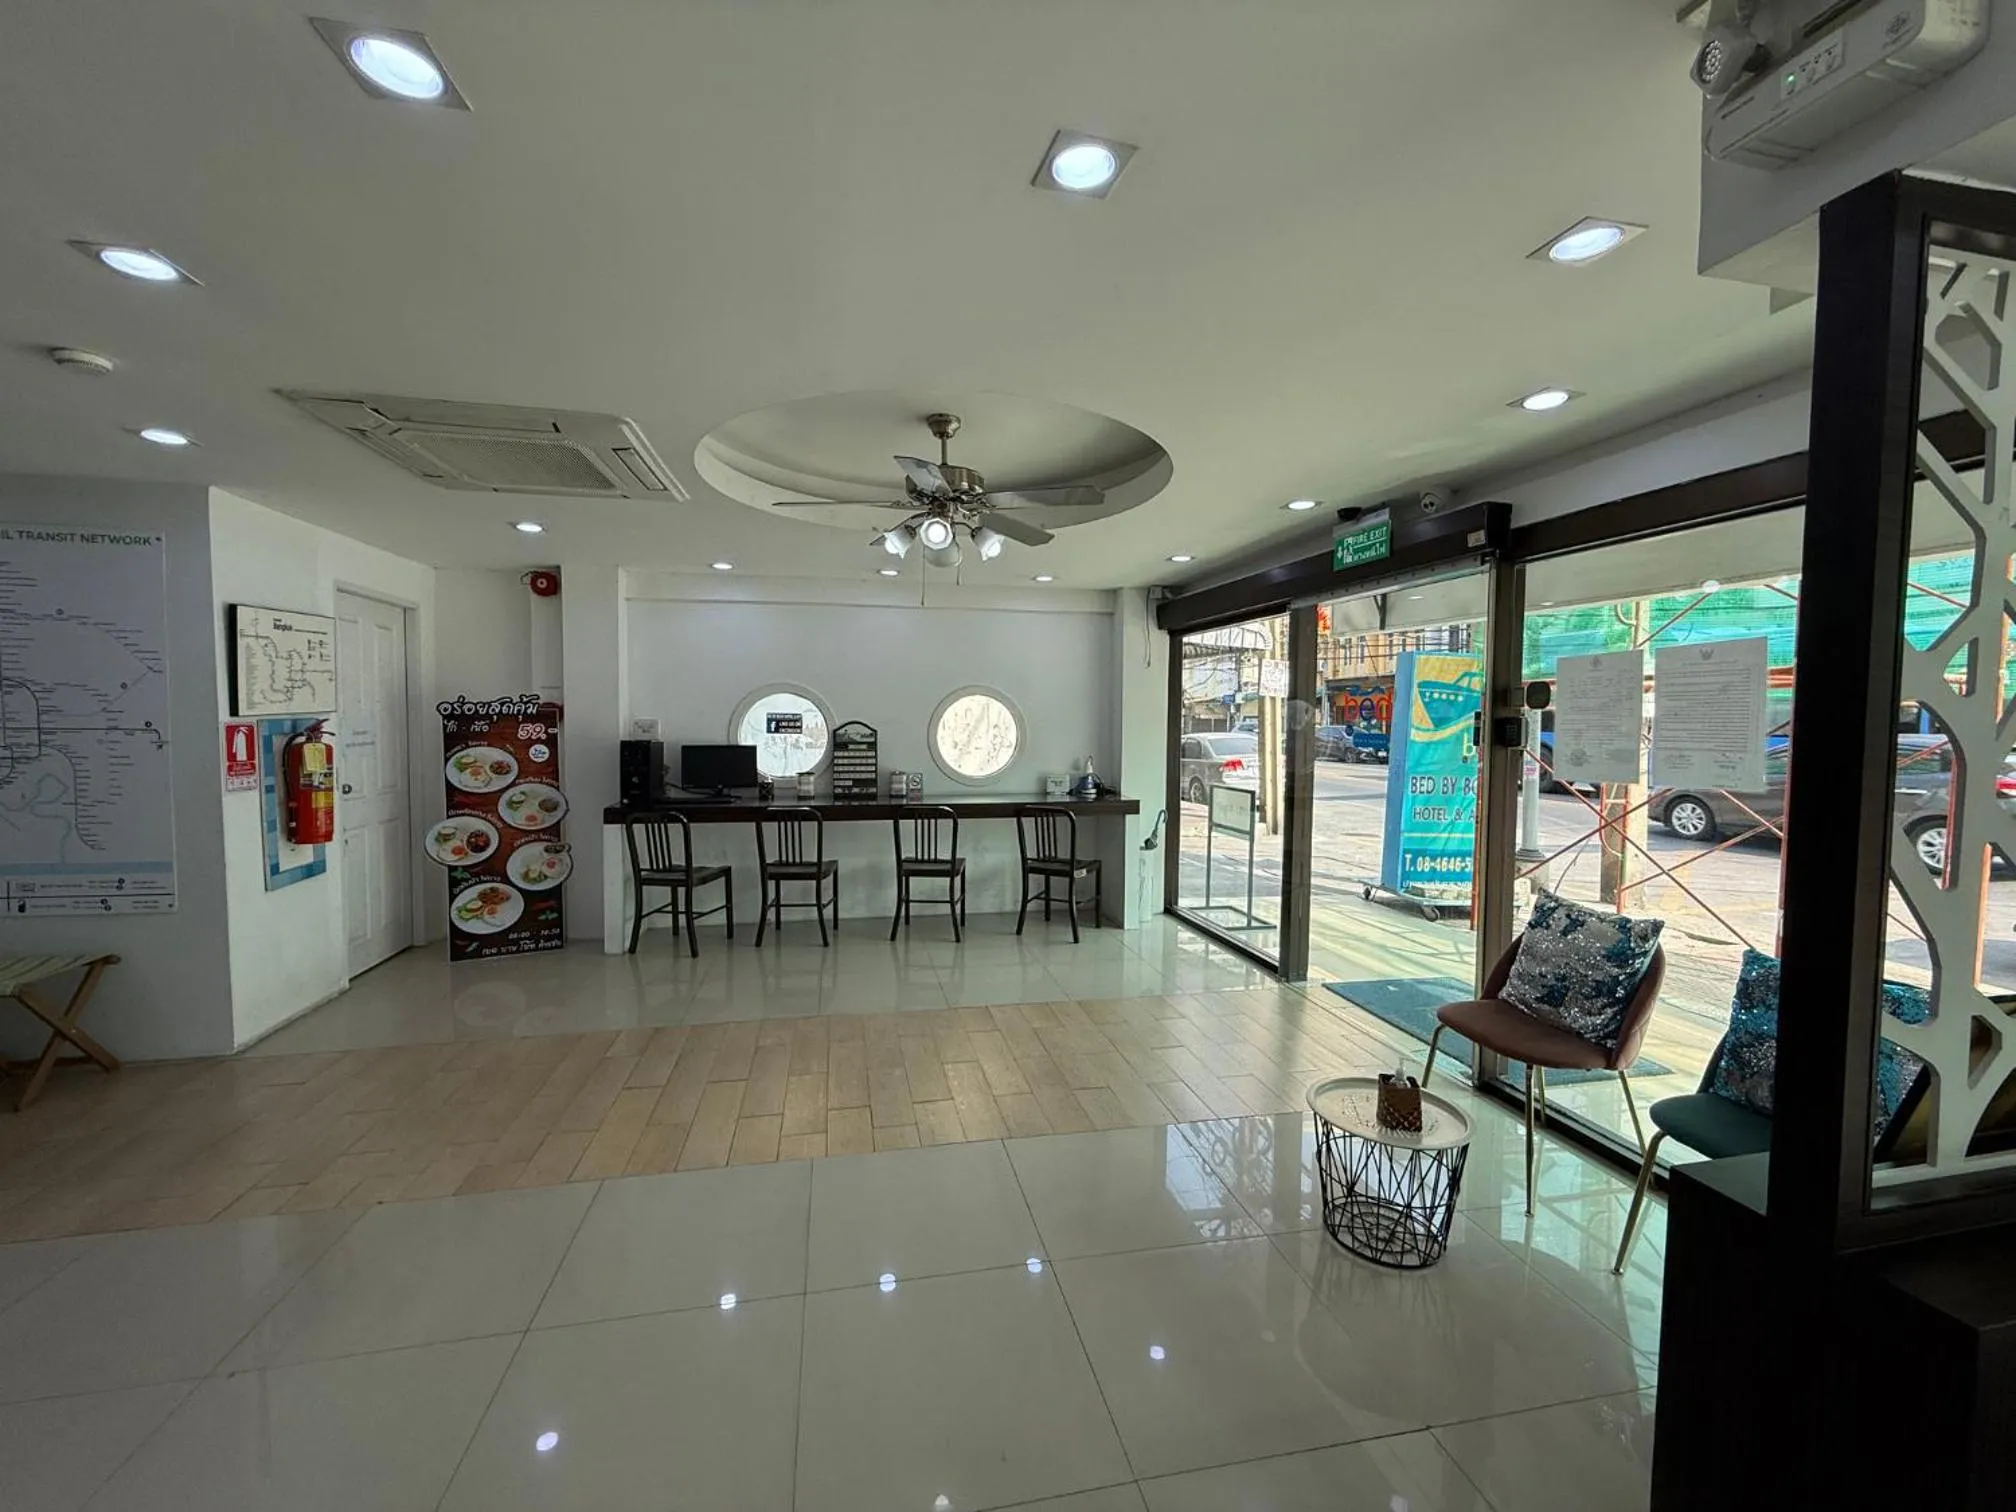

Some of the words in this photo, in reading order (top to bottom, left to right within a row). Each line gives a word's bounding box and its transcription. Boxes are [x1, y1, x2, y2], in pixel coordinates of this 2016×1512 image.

[16, 529, 76, 543] TRANSIT
[80, 533, 152, 546] NETWORK
[1410, 776, 1436, 795] BED
[1441, 776, 1458, 795] BY
[1413, 807, 1448, 821] HOTEL
[1454, 808, 1463, 821] &
